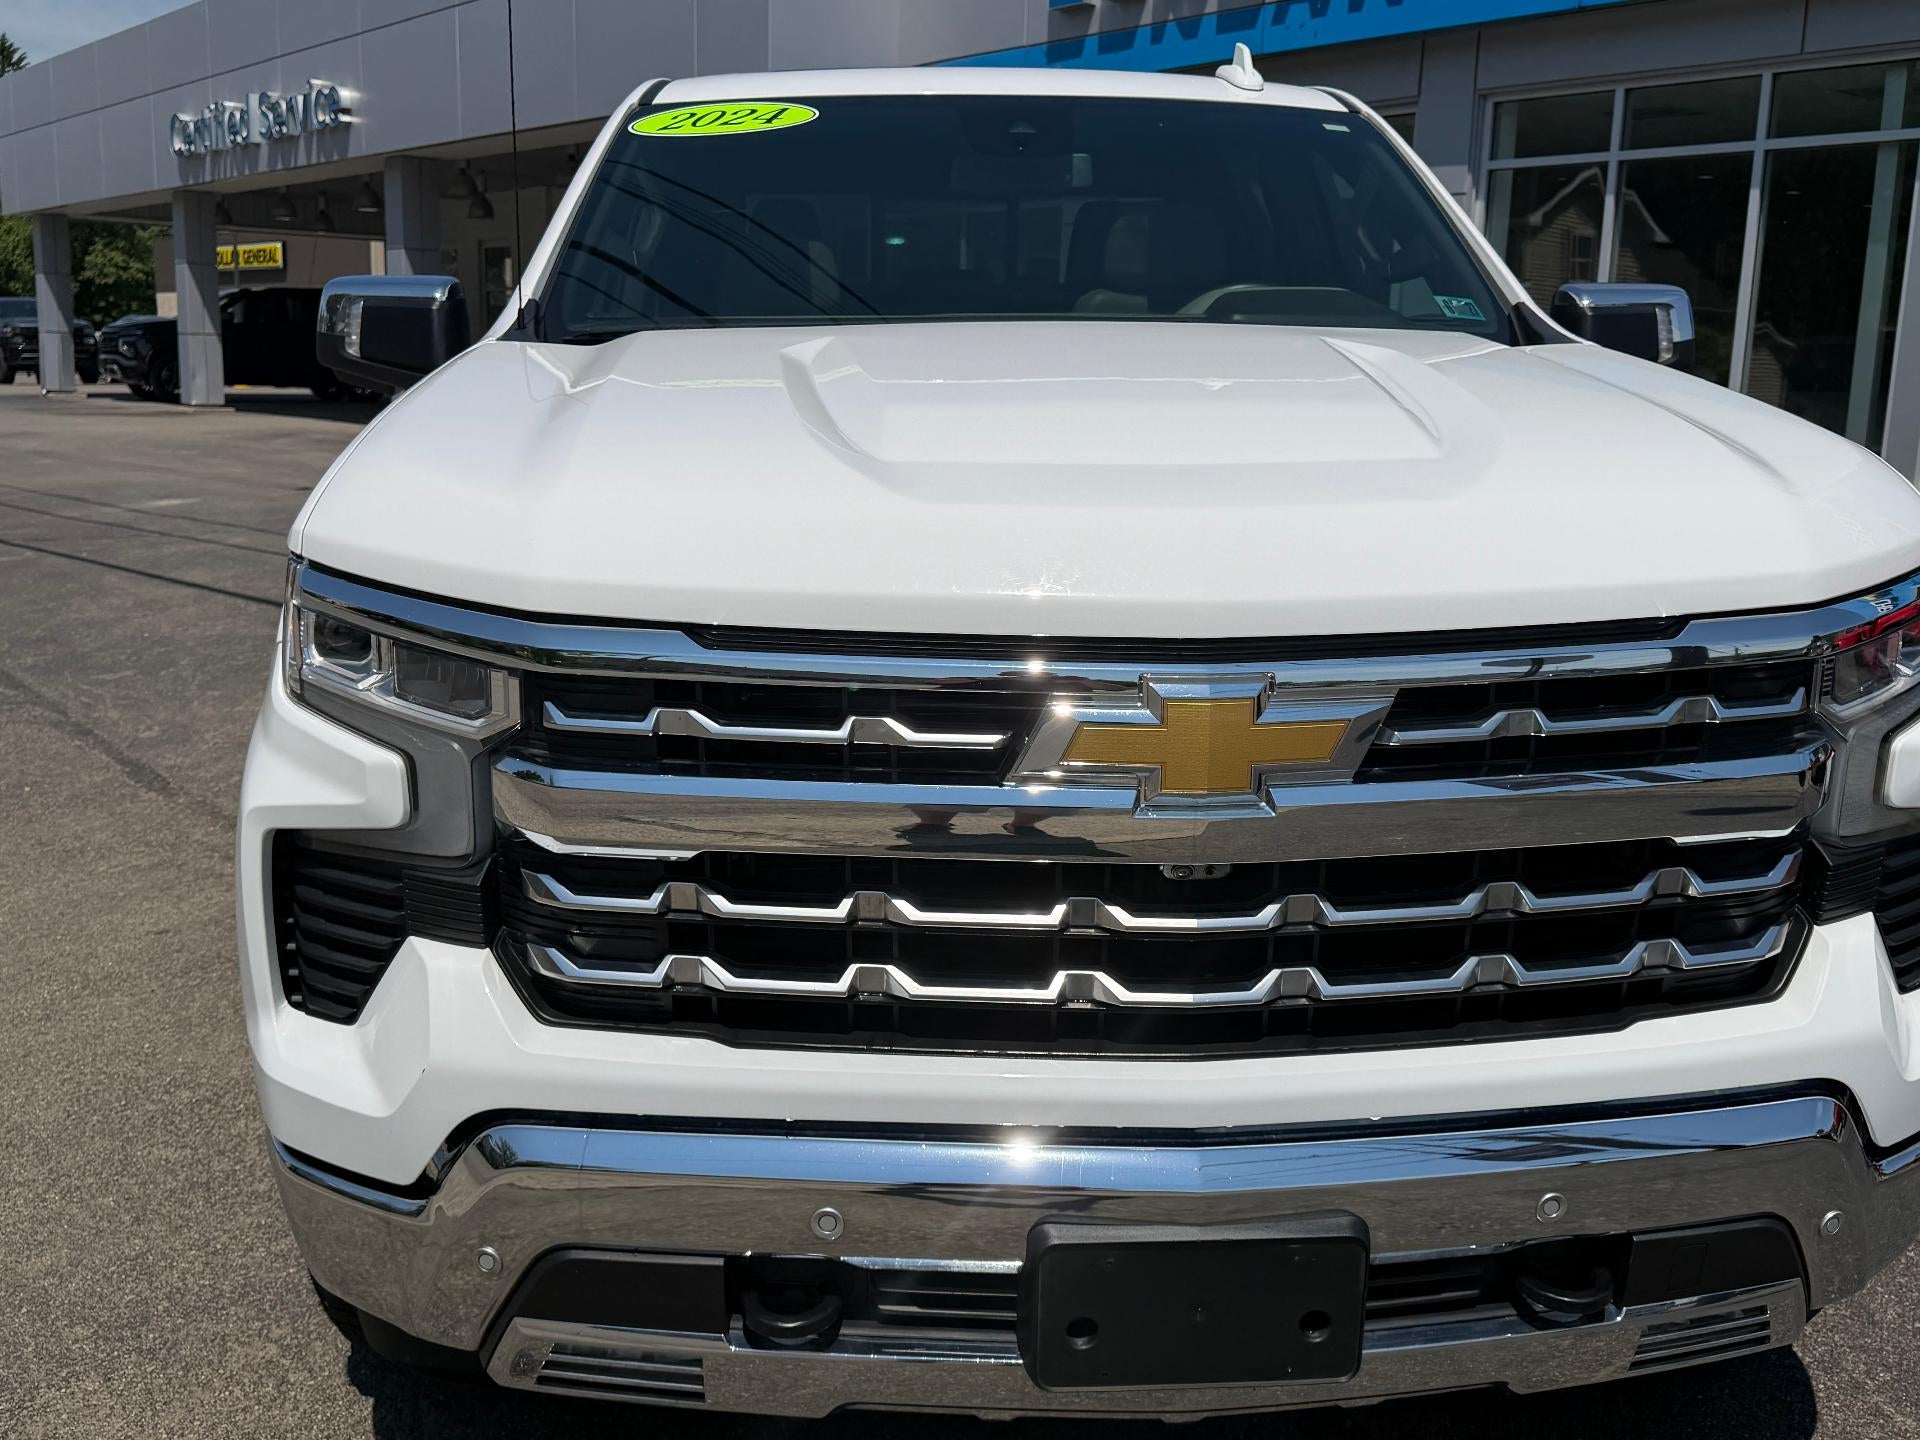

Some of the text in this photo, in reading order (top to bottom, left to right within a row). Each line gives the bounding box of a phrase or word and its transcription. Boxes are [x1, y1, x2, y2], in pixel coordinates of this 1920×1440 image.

[170, 79, 346, 157] Certified Service
[656, 107, 790, 131] 2024
[243, 246, 279, 264] GENERAL
